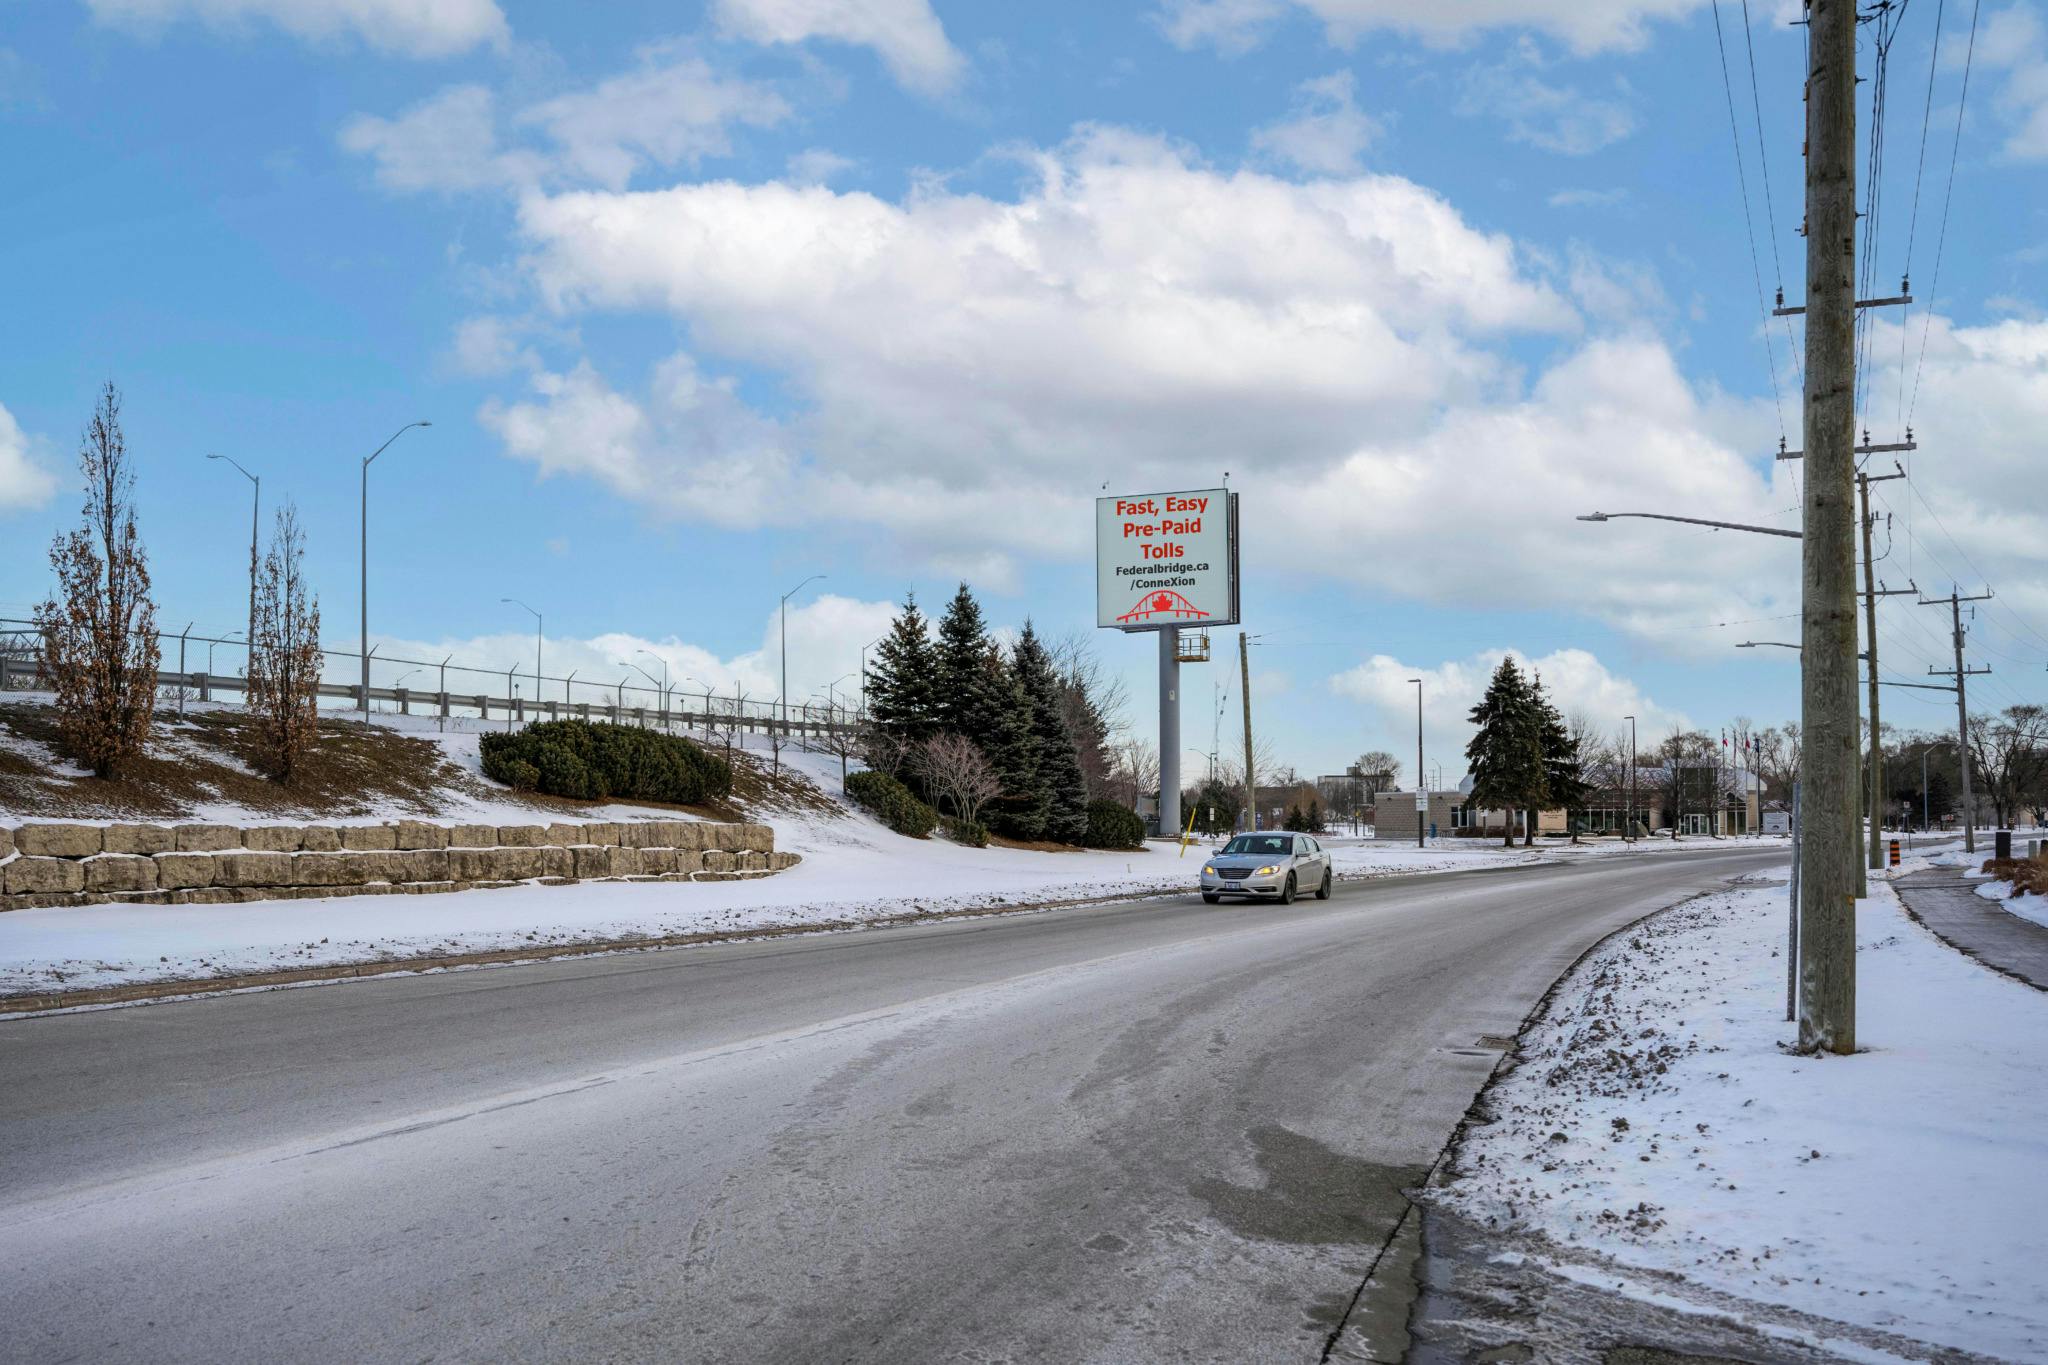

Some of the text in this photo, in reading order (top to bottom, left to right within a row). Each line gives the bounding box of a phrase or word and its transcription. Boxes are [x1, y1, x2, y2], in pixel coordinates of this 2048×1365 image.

[1116, 496, 1208, 516] Fast, Easy
[1124, 517, 1201, 538] Pre-Paid
[1140, 542, 1184, 559] Tolls
[1116, 561, 1209, 576] Federalbridge.ca
[1130, 576, 1196, 590] /ConneXion
